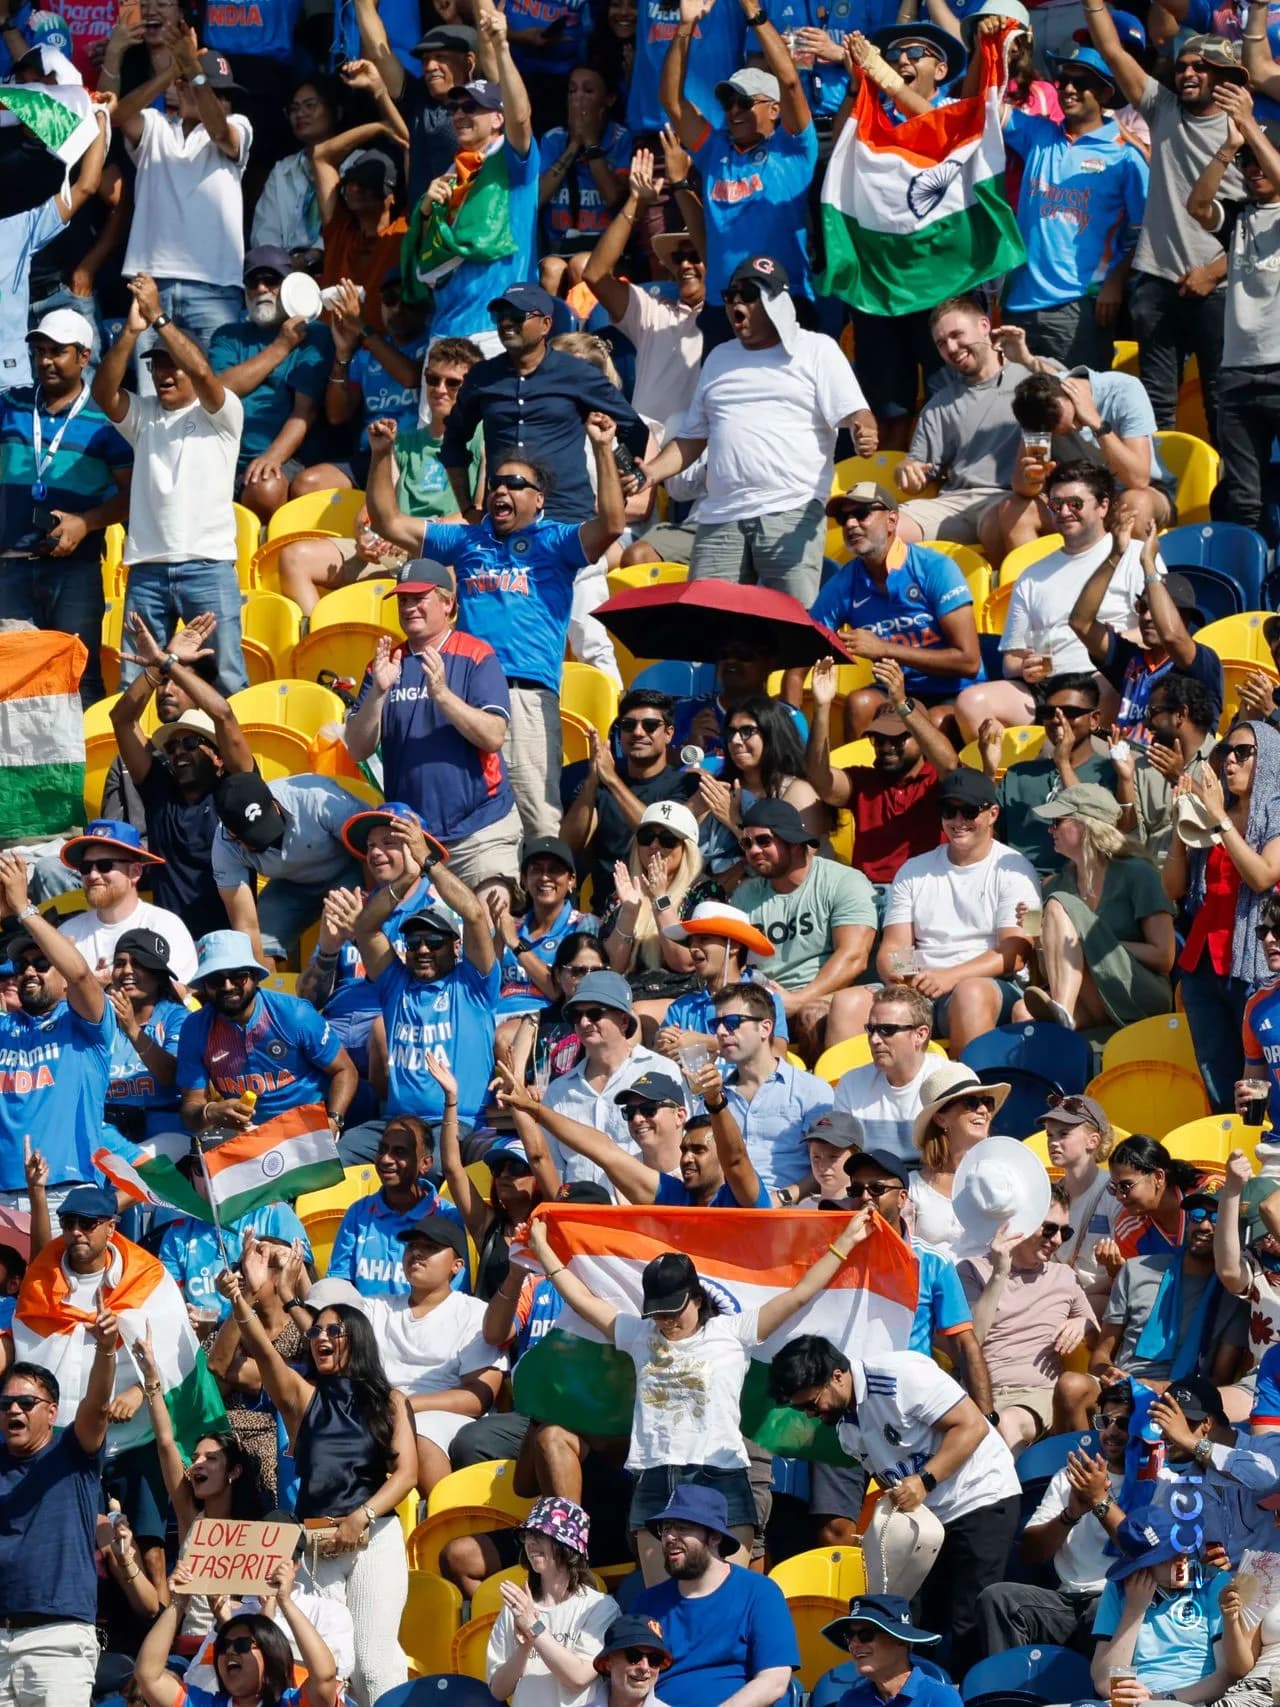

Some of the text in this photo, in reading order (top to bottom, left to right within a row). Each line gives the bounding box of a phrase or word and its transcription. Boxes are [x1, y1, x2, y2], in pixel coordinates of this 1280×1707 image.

[762, 911, 814, 945] OSS
[215, 1067, 296, 1098] INDIA
[193, 1520, 281, 1548] LOVE U
